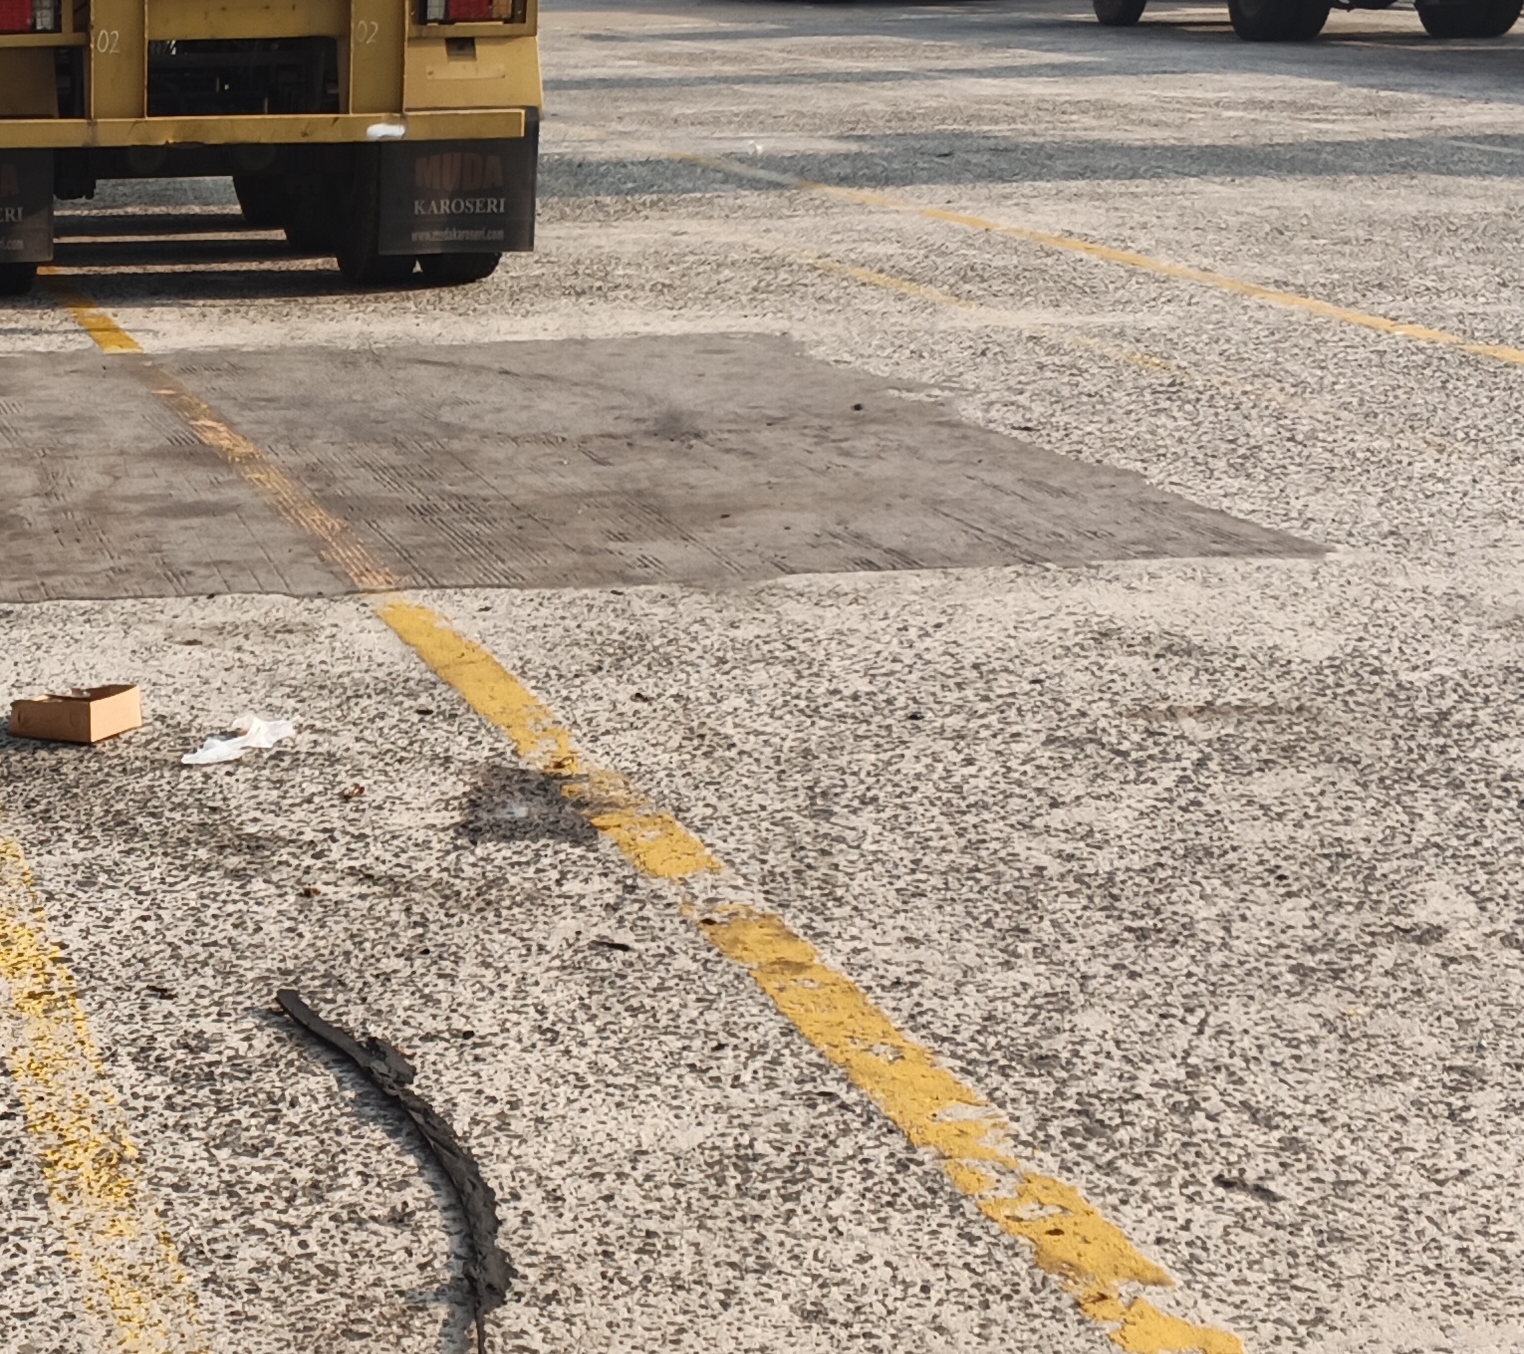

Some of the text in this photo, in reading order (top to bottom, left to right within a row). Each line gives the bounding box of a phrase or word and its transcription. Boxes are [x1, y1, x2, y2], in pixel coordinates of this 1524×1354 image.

[96, 30, 121, 54] 02
[356, 20, 379, 45] 02
[414, 152, 504, 191] MUDA
[414, 197, 506, 215] KAROSERI
